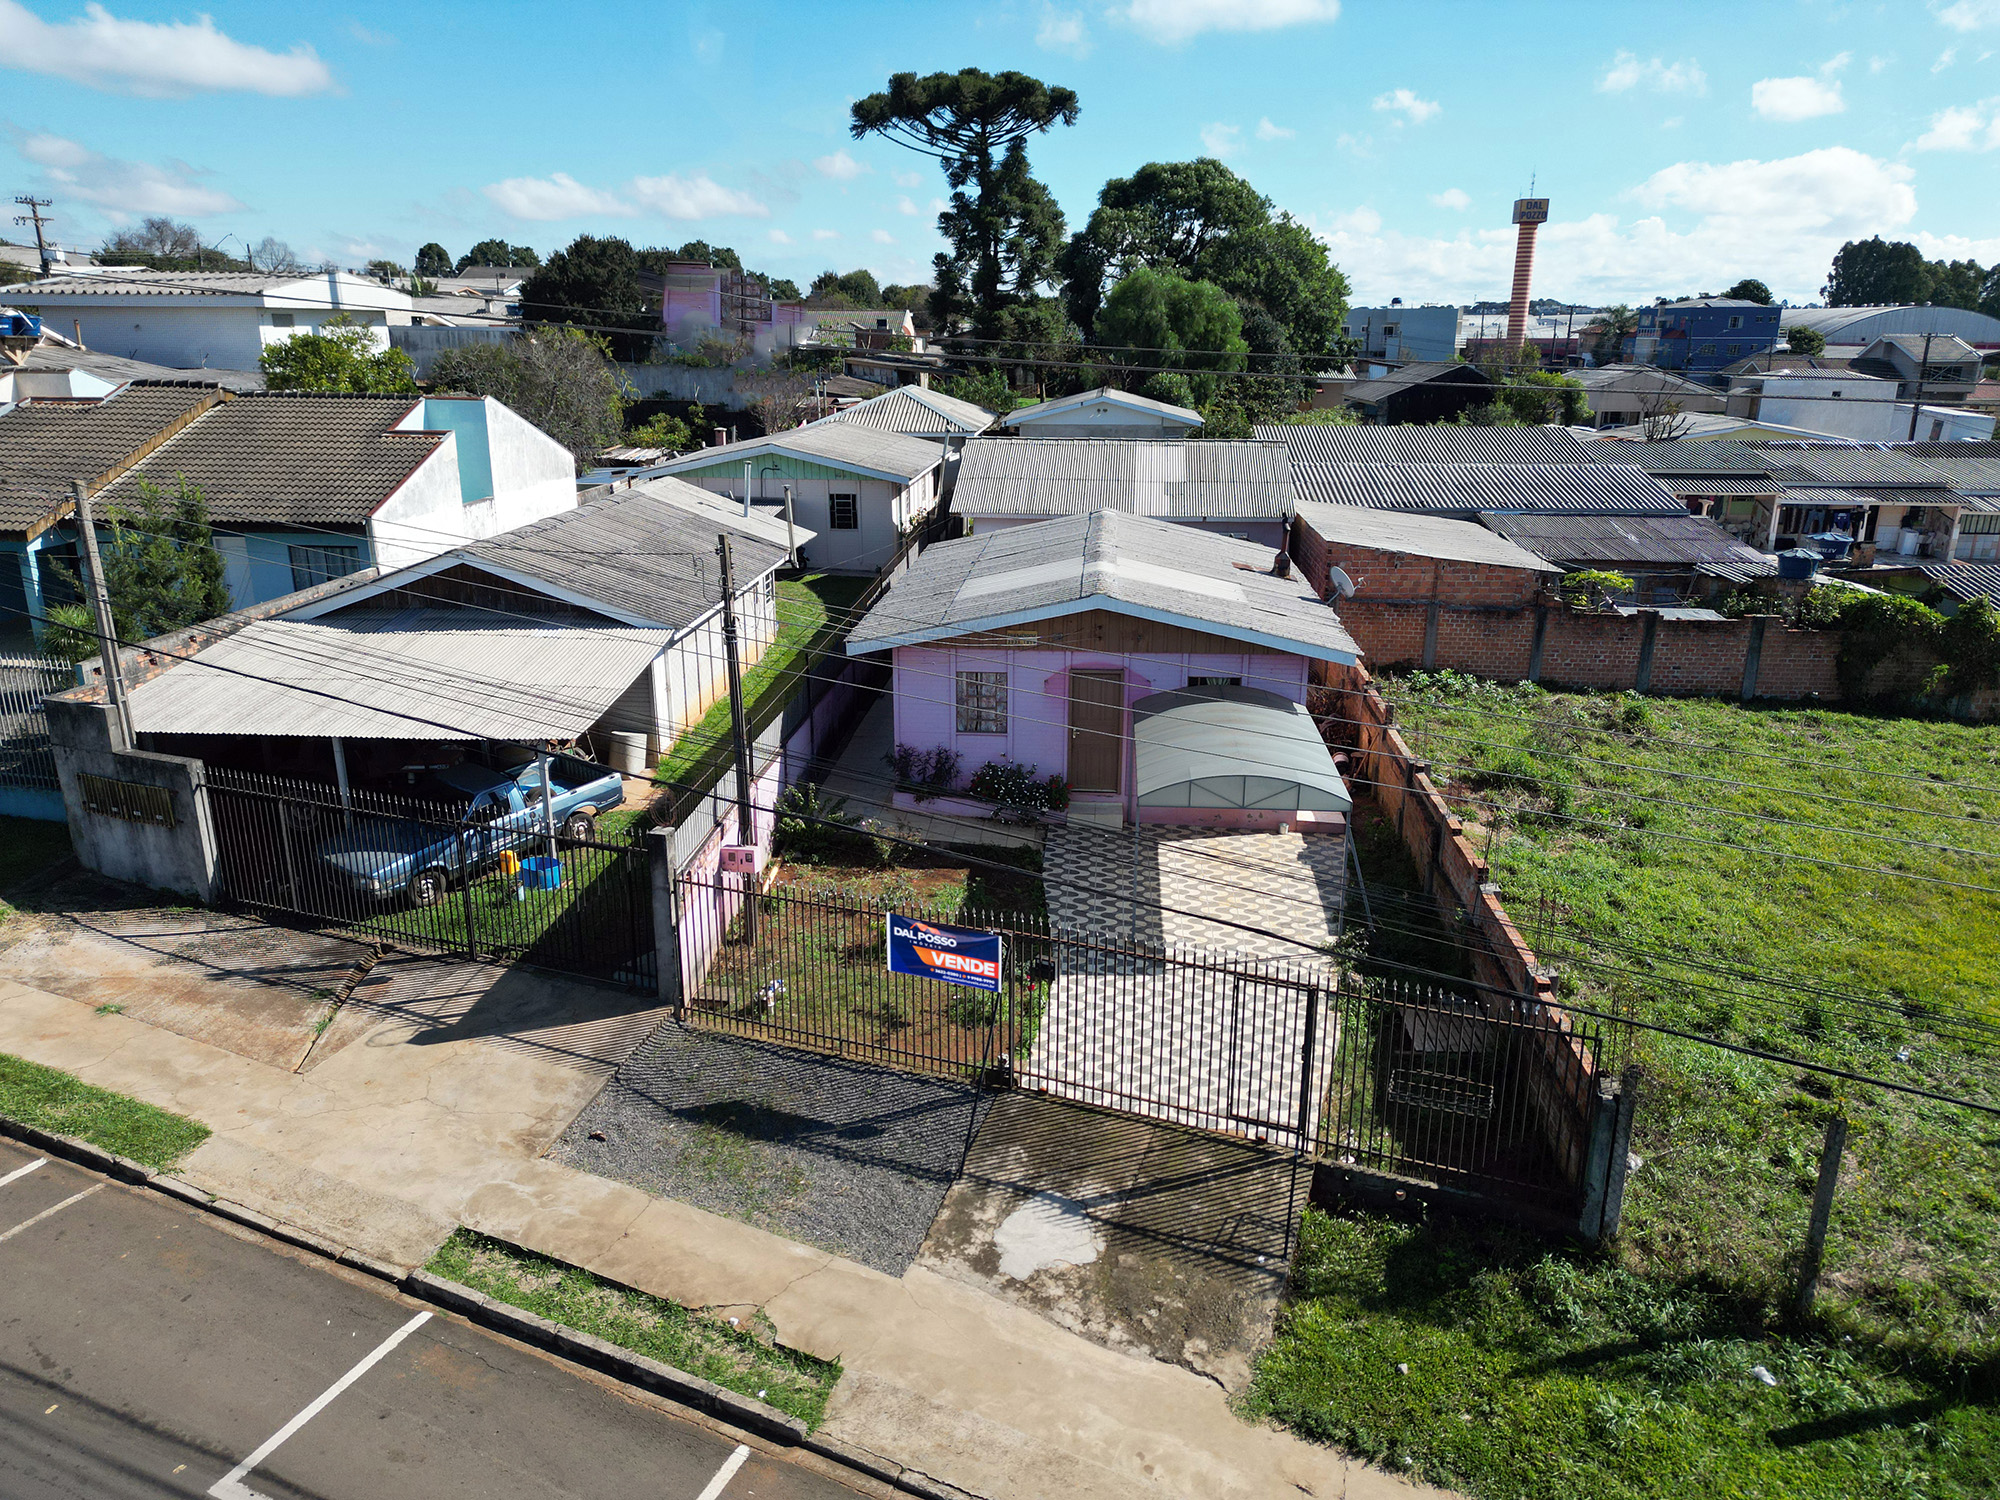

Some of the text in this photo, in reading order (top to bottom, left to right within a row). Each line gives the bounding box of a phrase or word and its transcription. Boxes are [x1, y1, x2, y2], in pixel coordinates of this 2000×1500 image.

[1526, 201, 1543, 209] DAL
[1521, 211, 1547, 219] POZZO
[894, 926, 957, 948] DAL POSSO
[931, 951, 995, 977] VENDE
